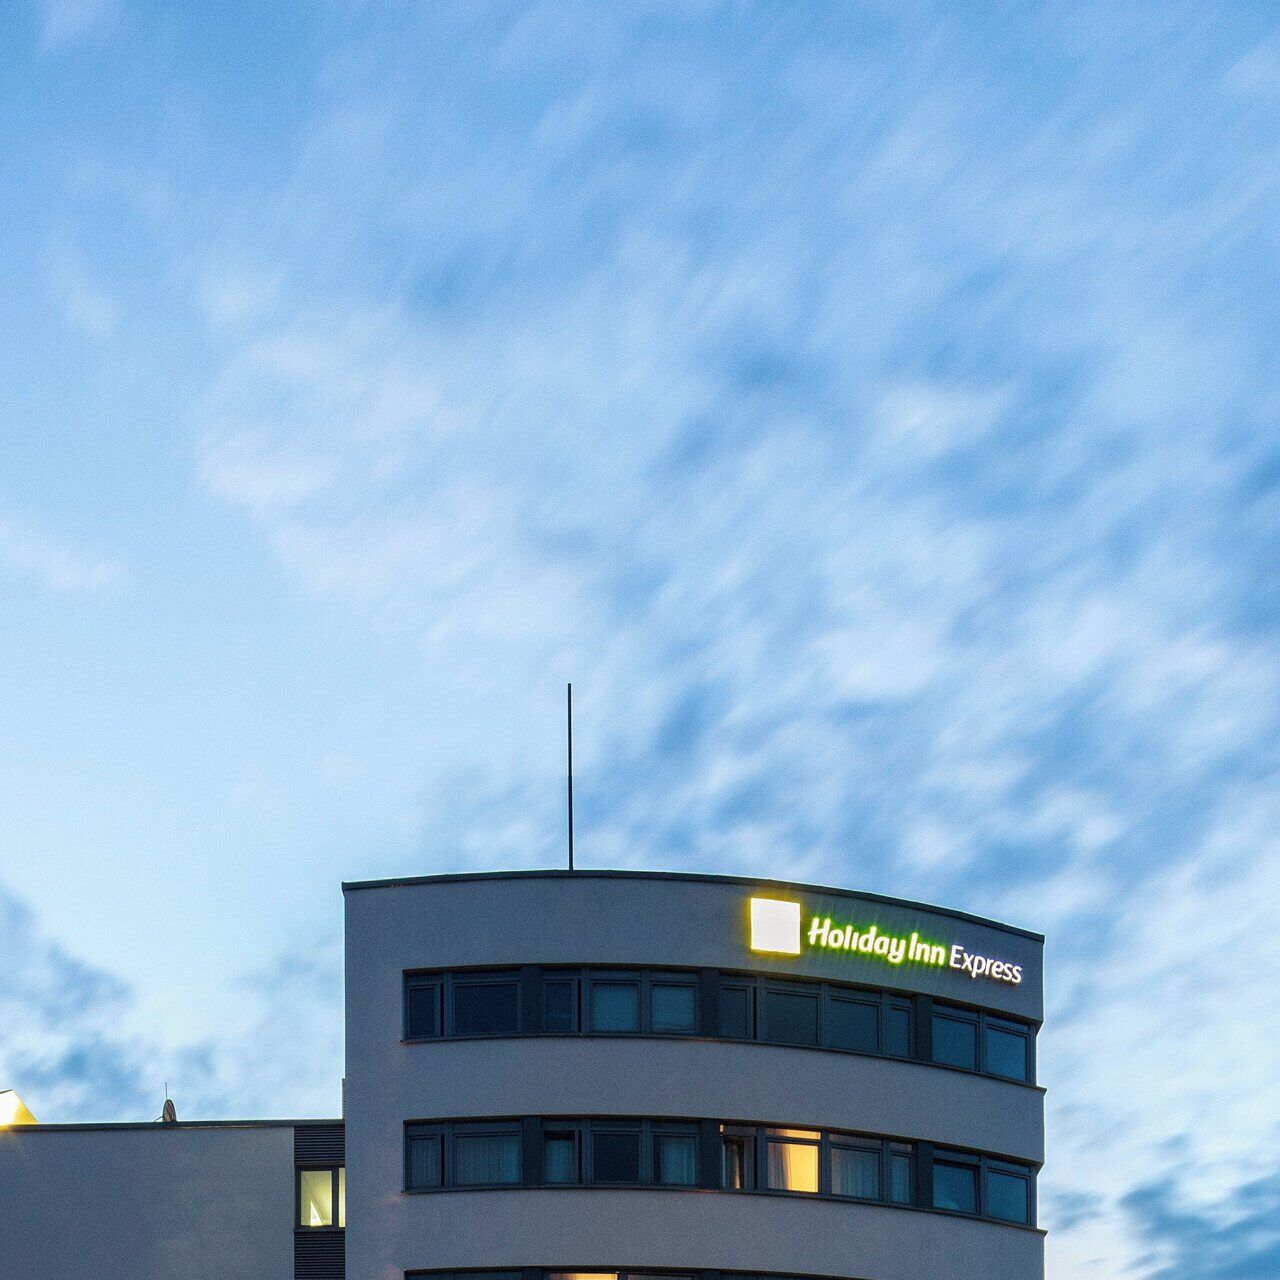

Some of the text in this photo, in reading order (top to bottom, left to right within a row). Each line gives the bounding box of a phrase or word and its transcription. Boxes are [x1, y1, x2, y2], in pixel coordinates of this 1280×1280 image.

[808, 917, 1022, 984] Holiday Inn Express
